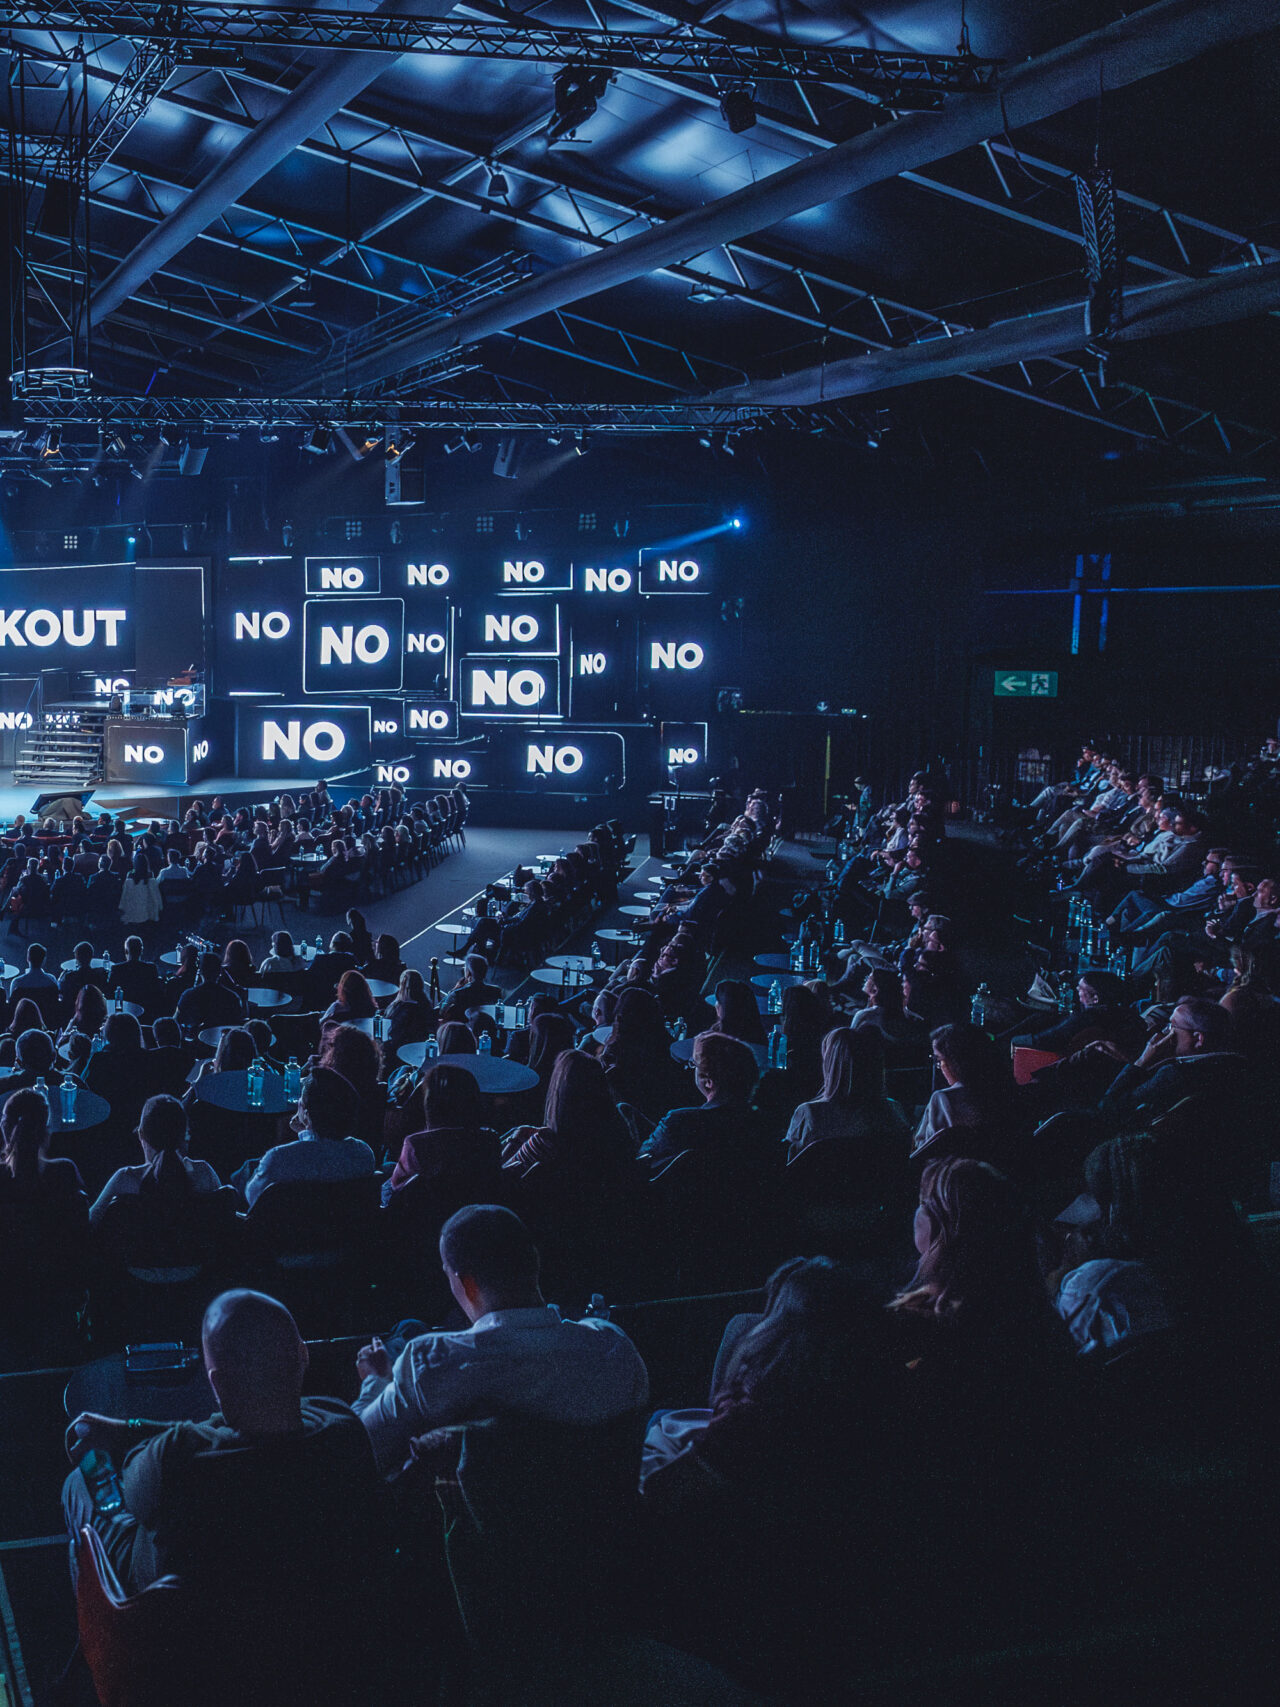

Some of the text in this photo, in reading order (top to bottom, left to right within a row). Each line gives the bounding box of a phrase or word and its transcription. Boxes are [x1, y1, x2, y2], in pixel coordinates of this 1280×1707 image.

[321, 567, 364, 589] NO
[408, 564, 449, 585] NO
[504, 561, 544, 582] NO
[585, 568, 631, 592] NO
[660, 560, 699, 581] NO
[235, 612, 290, 640] NO
[485, 615, 538, 642] NO
[320, 625, 389, 665] NO
[408, 634, 445, 653] NO
[580, 653, 606, 675] NO
[651, 643, 704, 669] NO
[472, 670, 545, 706] NO
[374, 720, 397, 733] NO
[410, 709, 448, 729] NO
[193, 740, 208, 763] NO
[262, 721, 345, 761] NO
[125, 744, 164, 764] NO
[527, 745, 583, 773] NO
[669, 748, 698, 763] NO
[377, 766, 409, 782] NO
[434, 759, 471, 778] NO
